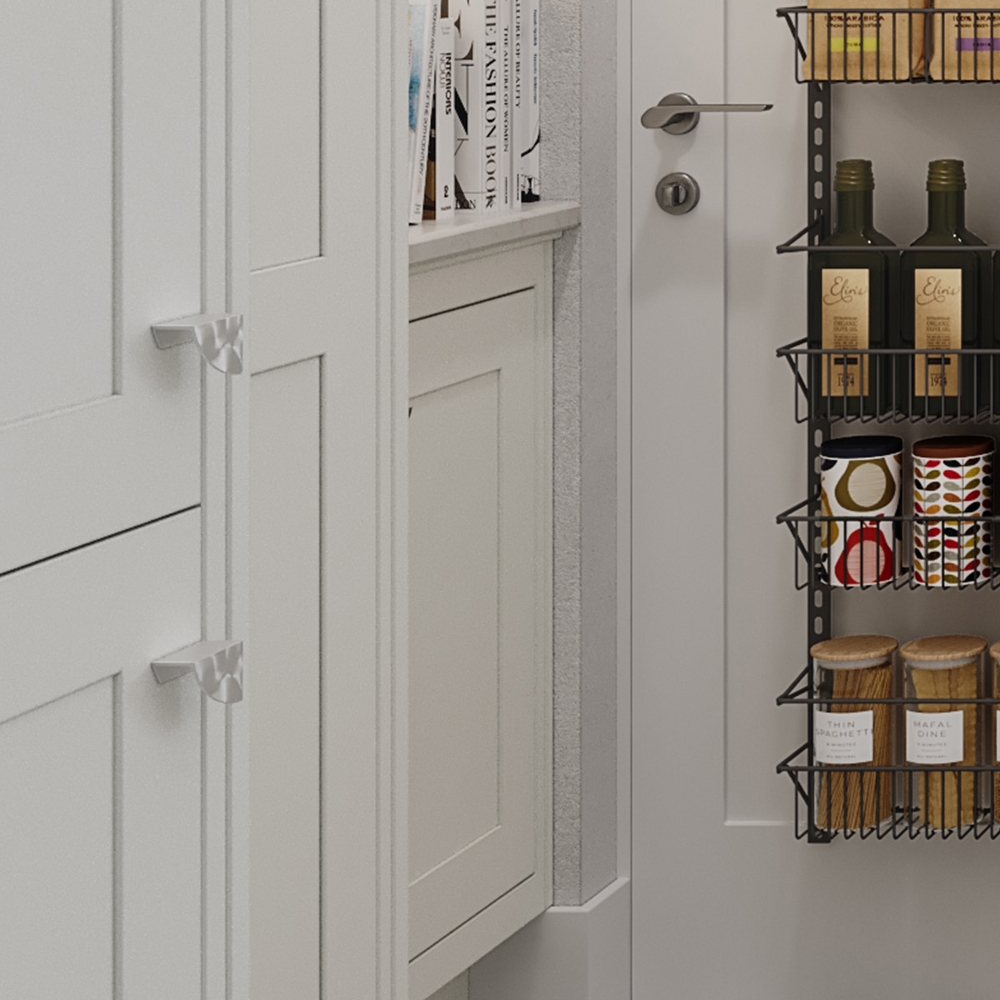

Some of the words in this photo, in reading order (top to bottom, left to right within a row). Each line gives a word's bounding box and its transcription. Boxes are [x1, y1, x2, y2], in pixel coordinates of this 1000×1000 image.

[515, 43, 521, 58] OF
[445, 52, 453, 115] INTERIORS
[484, 41, 498, 138] FASHION
[503, 94, 509, 108] OF
[484, 145, 498, 209] BOOK
[913, 720, 952, 728] MAFAL
[917, 730, 946, 738] DINE
